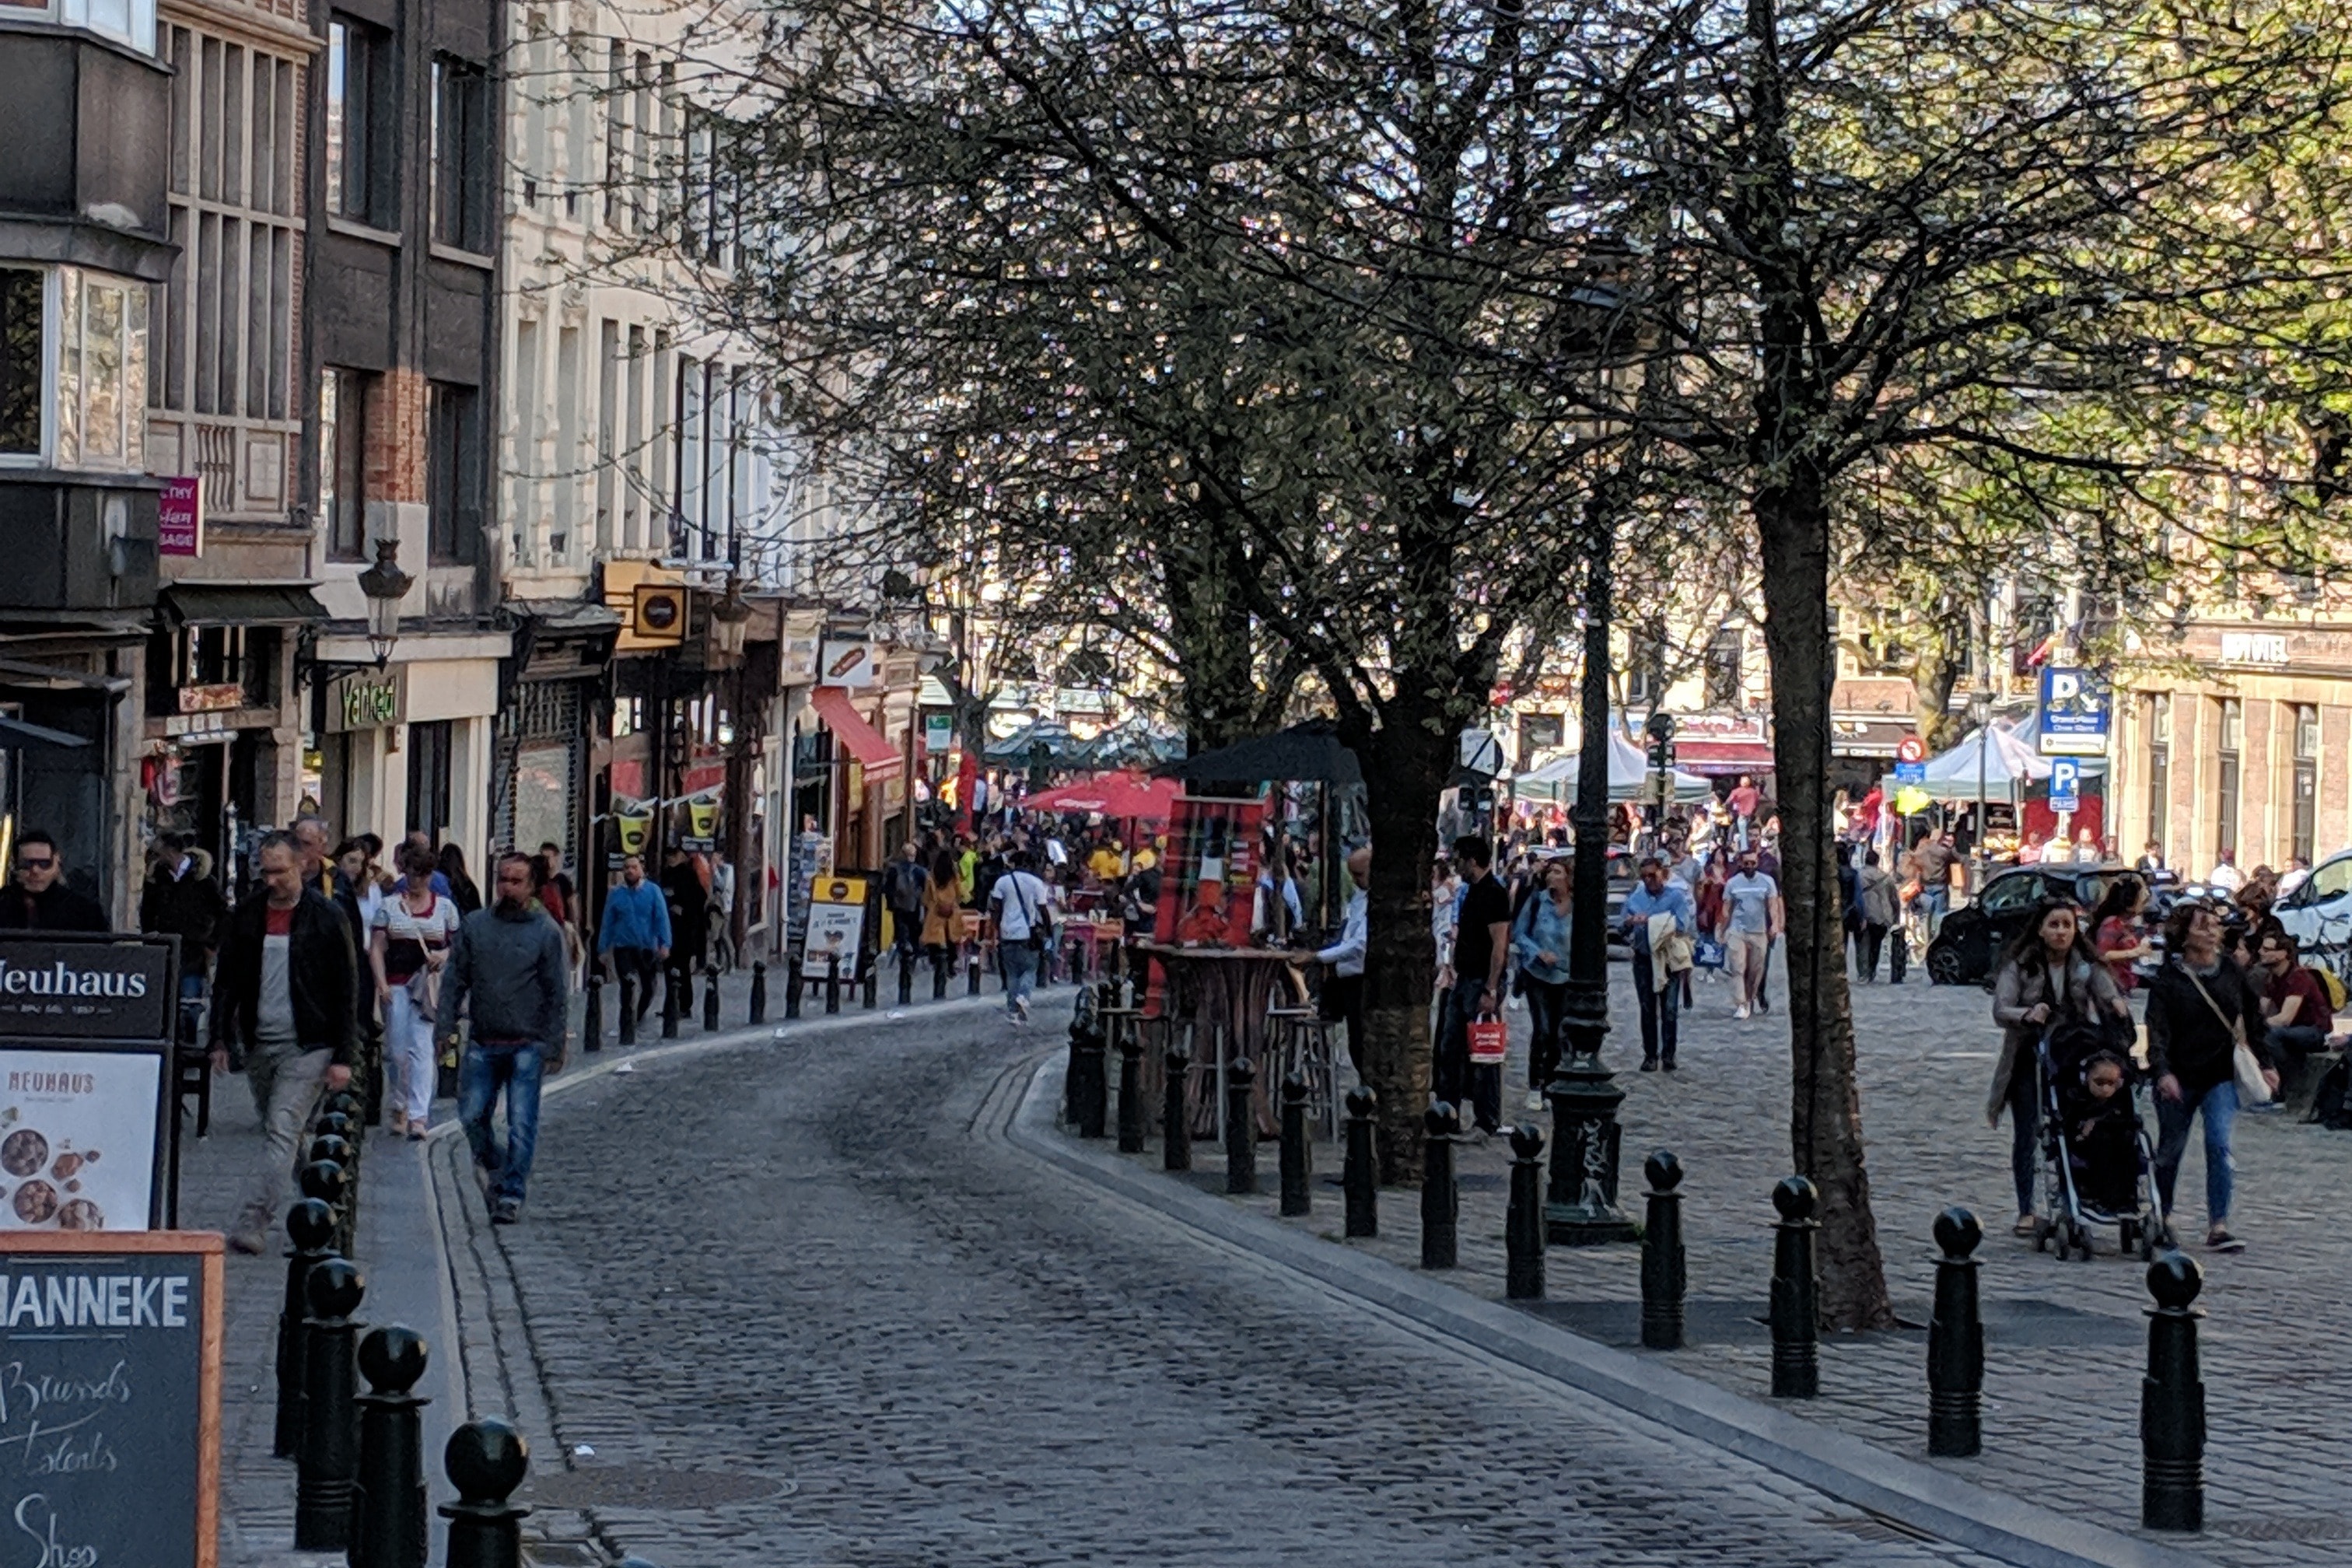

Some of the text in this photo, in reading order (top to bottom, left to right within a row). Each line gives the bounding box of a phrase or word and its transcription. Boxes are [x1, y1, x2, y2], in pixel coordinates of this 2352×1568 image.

[2055, 763, 2075, 791] P
[0, 959, 146, 998] euhaus
[0, 1276, 189, 1327] ANNEKE
